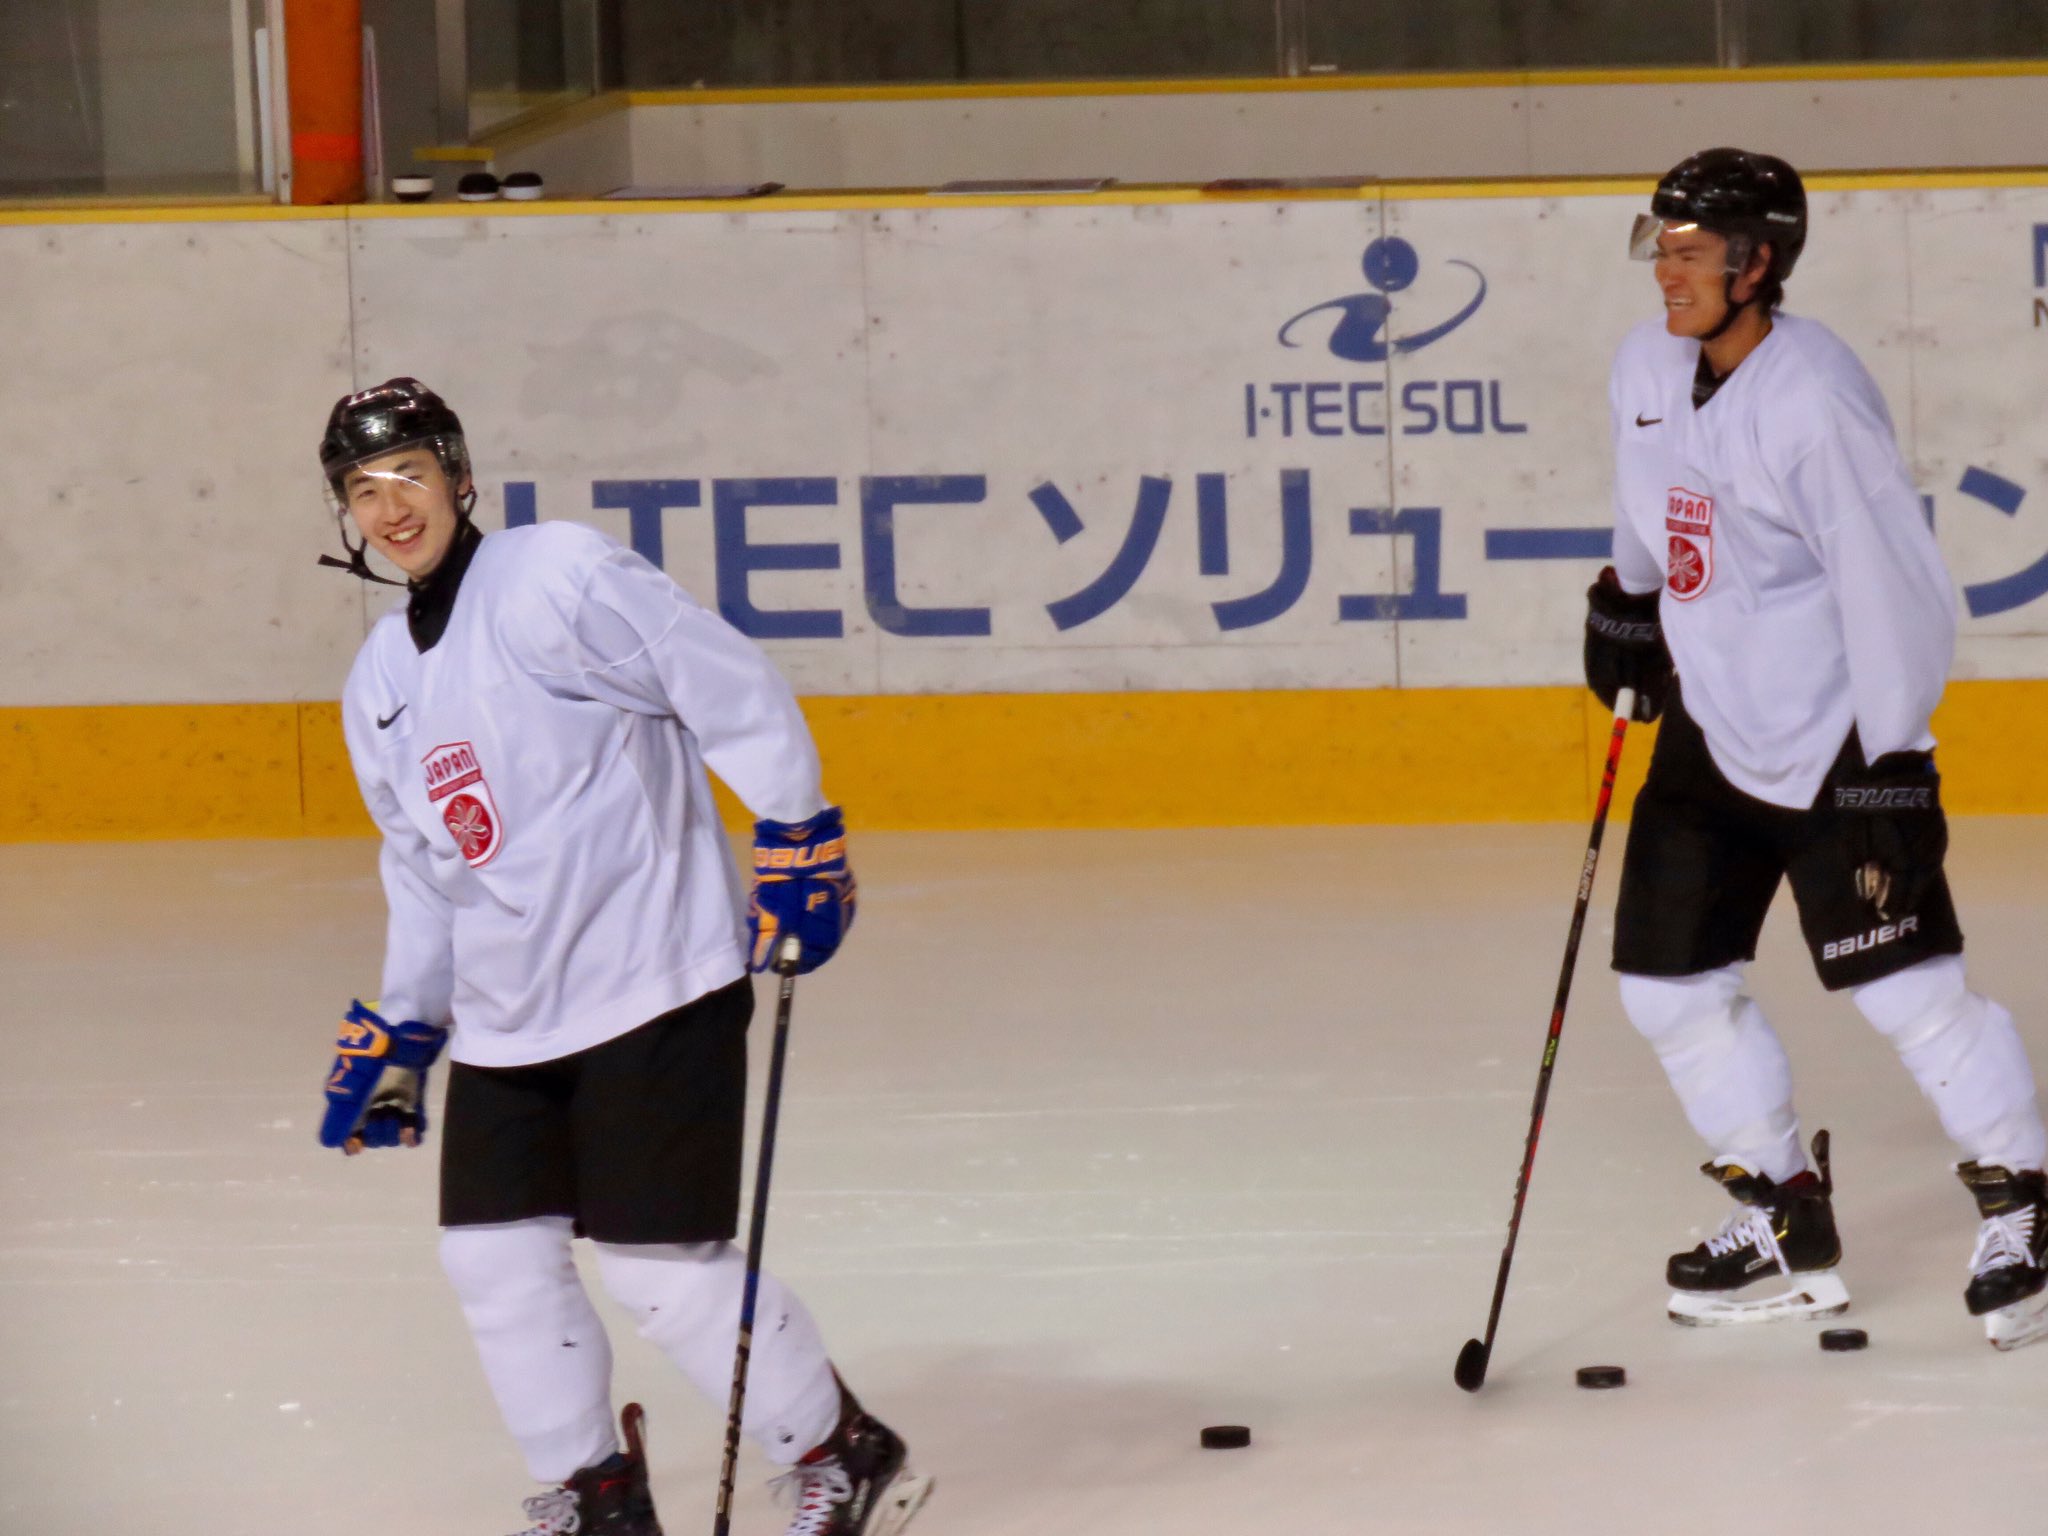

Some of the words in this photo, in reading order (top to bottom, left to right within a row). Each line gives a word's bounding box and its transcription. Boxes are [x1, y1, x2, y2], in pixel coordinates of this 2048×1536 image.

[1402, 379, 1527, 435] SOL
[425, 748, 474, 785] JAPAN
[1823, 915, 1918, 960] BAUER
